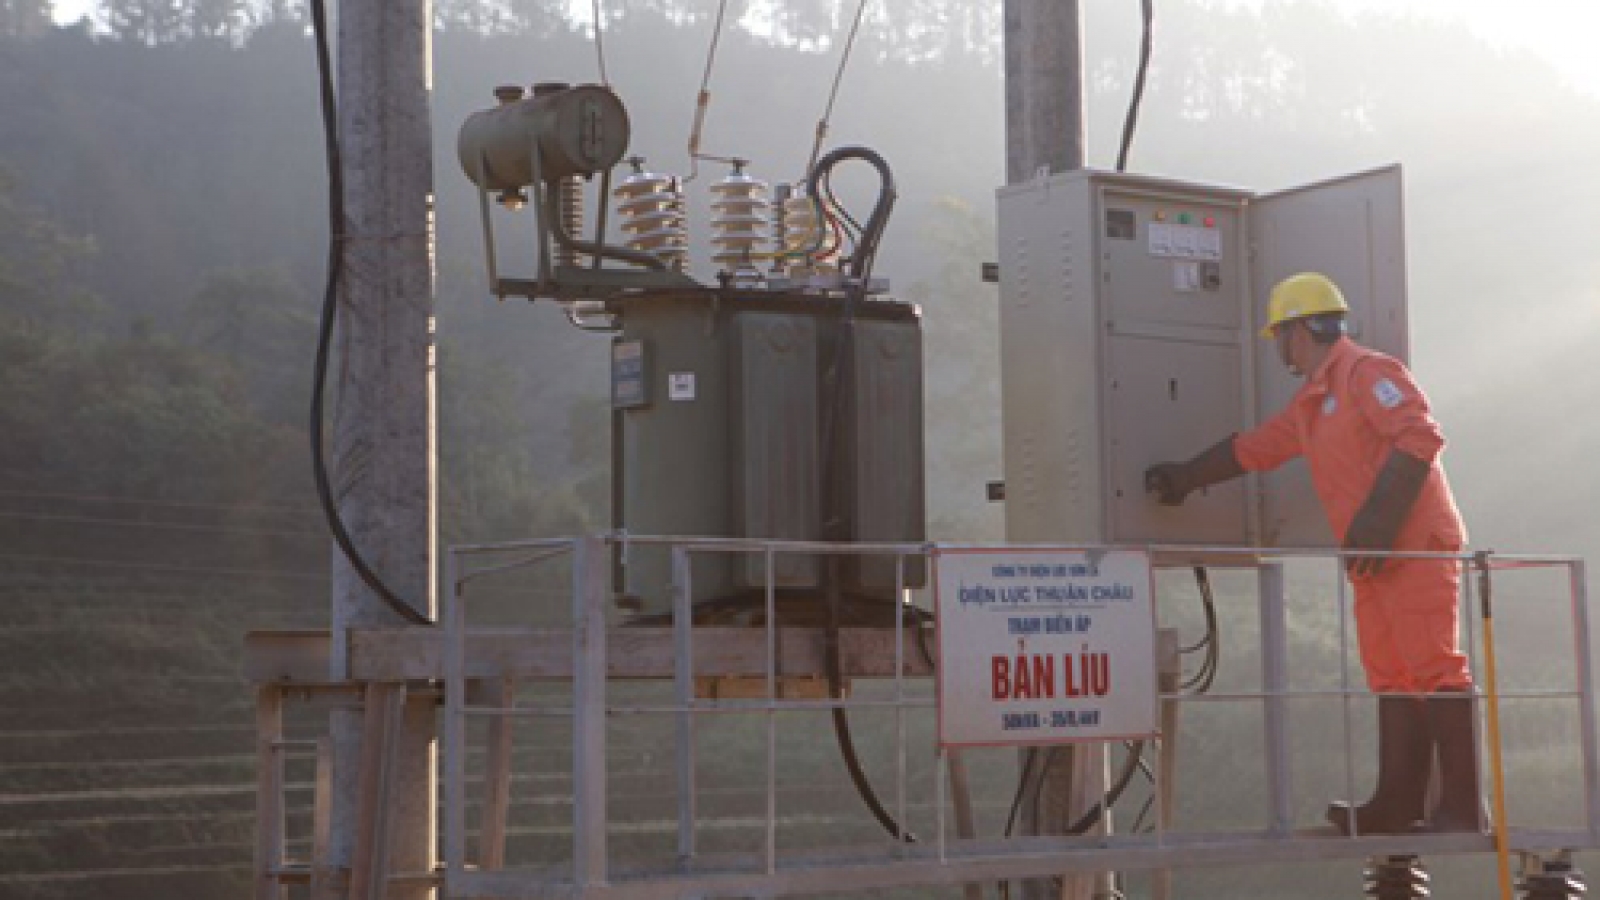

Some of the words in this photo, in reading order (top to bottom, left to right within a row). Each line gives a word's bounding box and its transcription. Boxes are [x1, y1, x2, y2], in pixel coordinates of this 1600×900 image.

[1036, 583, 1089, 605] THUẬN
[1091, 583, 1133, 602] CHÂU
[991, 637, 1054, 701] BẢN
[1065, 643, 1110, 698] LÍU
